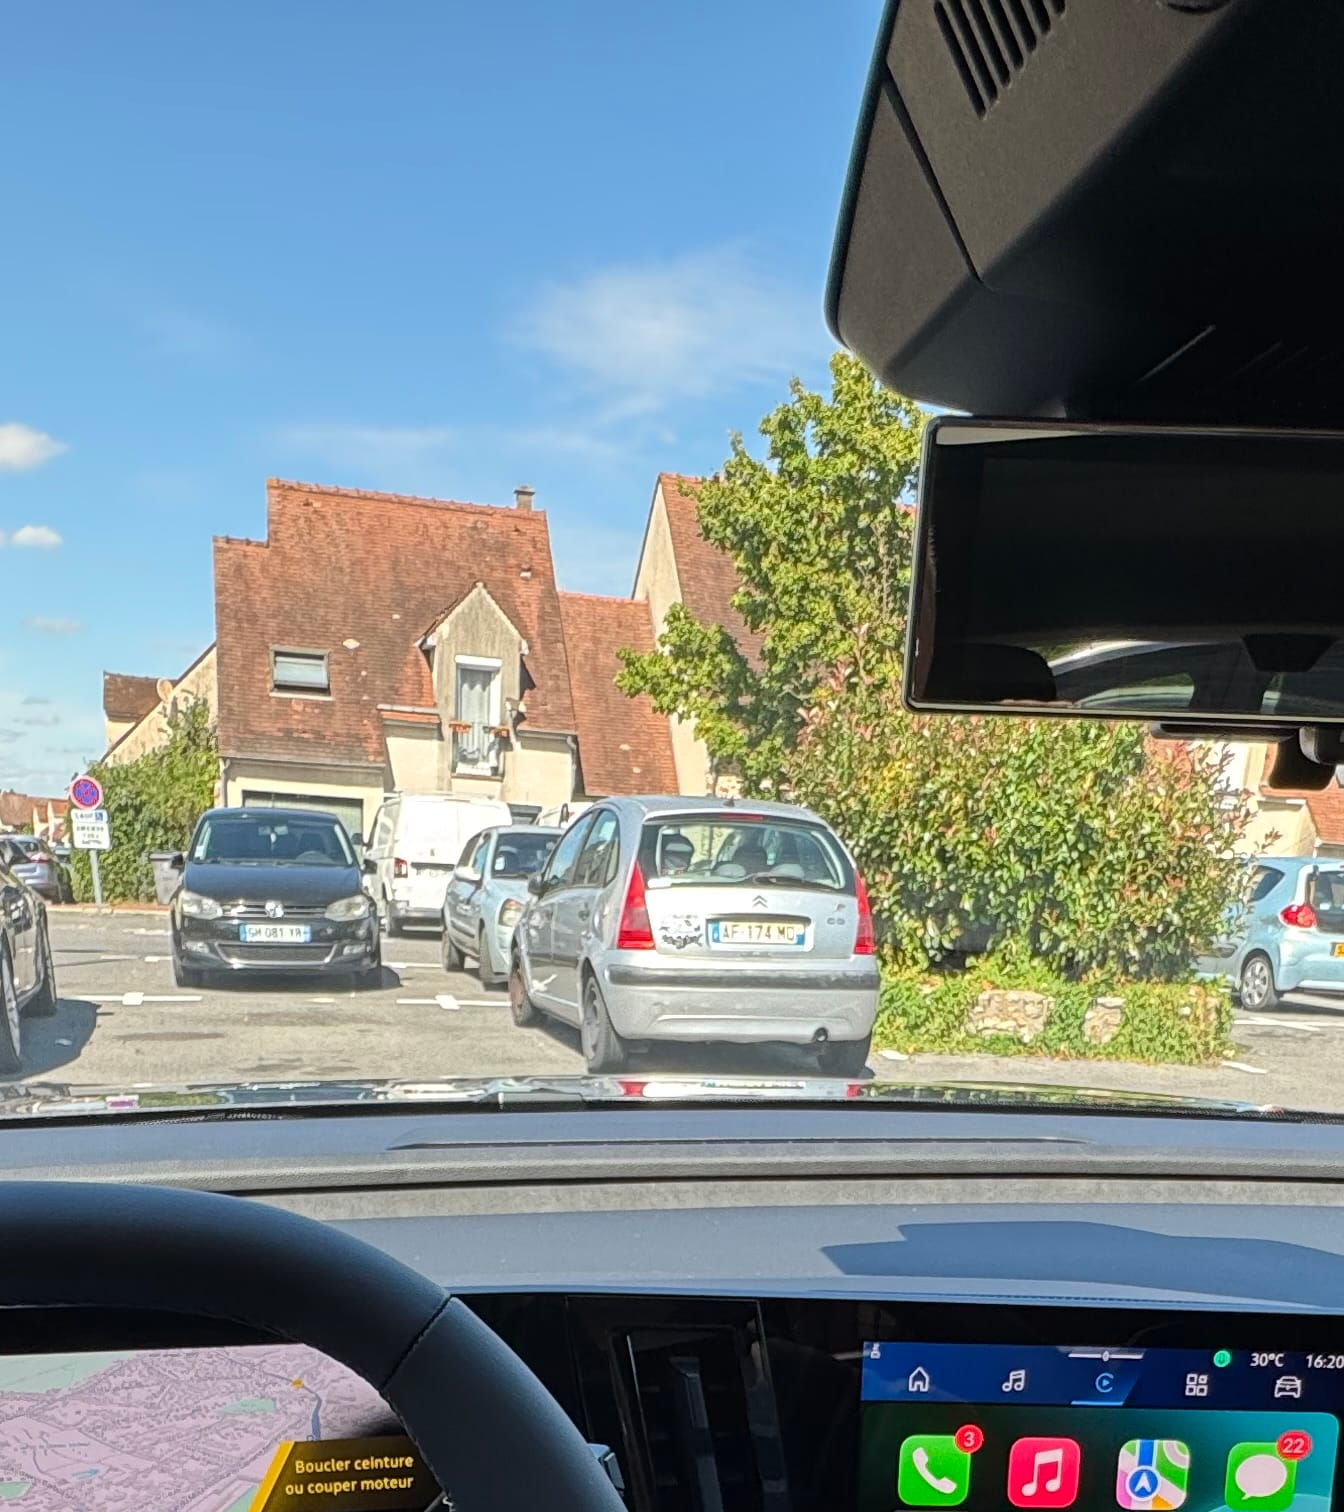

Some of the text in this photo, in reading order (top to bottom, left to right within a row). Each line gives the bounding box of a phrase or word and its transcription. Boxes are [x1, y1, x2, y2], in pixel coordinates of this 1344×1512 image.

[963, 1432, 975, 1448] 3
[1282, 1438, 1305, 1454] 22
[295, 1456, 415, 1474] Boucler ceinture
[285, 1476, 415, 1496] ou couper moteur
